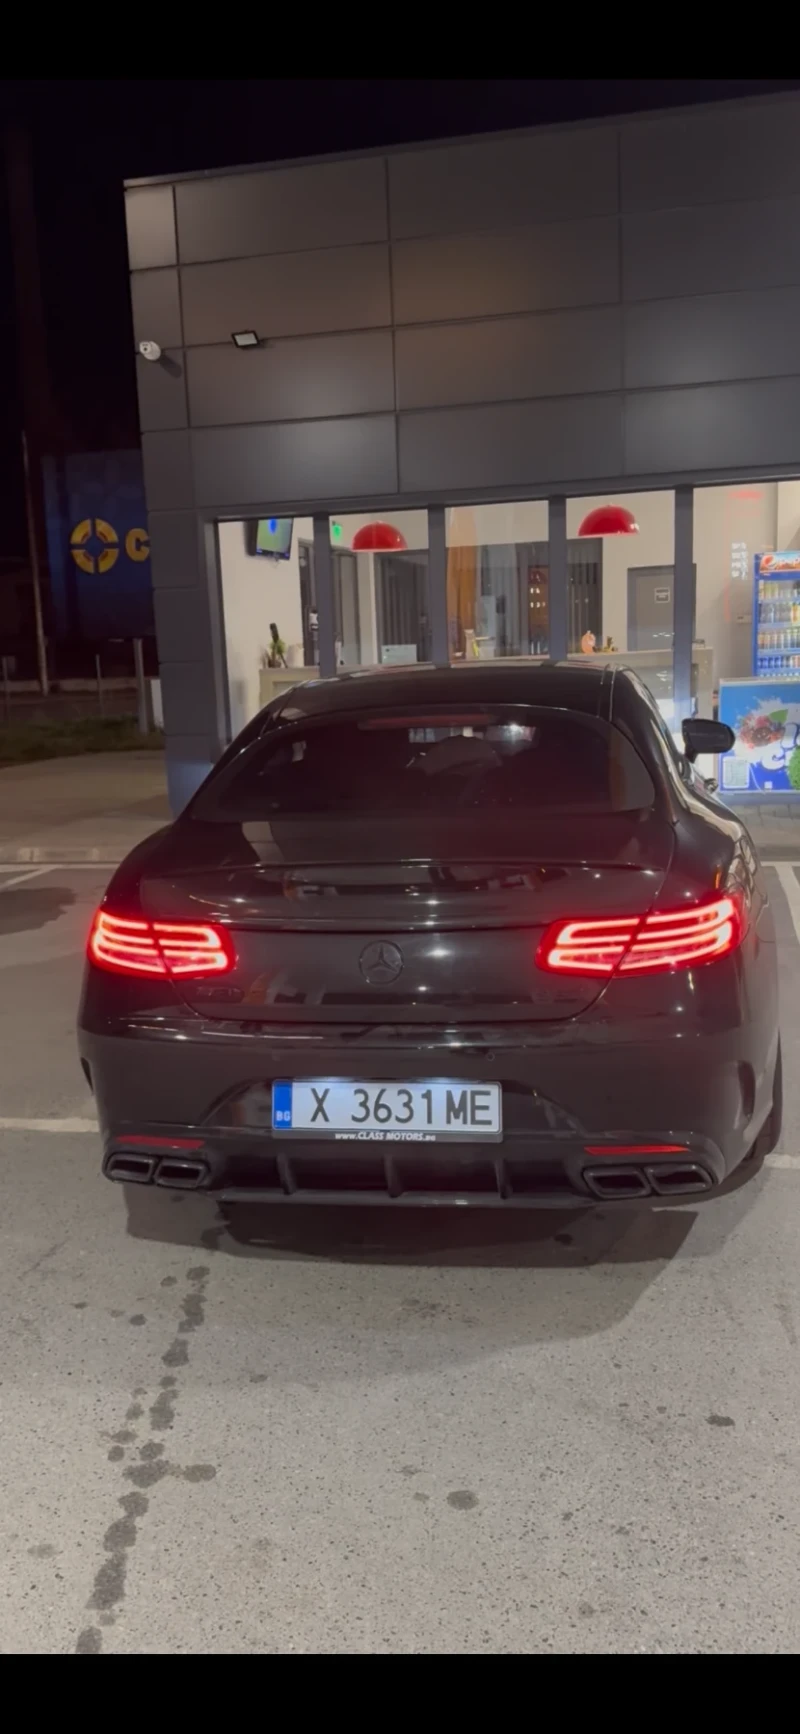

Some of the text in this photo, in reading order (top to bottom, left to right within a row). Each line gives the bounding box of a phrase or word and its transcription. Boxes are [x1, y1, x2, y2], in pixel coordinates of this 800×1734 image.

[276, 1111, 291, 1121] BG
[310, 1088, 492, 1126] X 3631 ME
